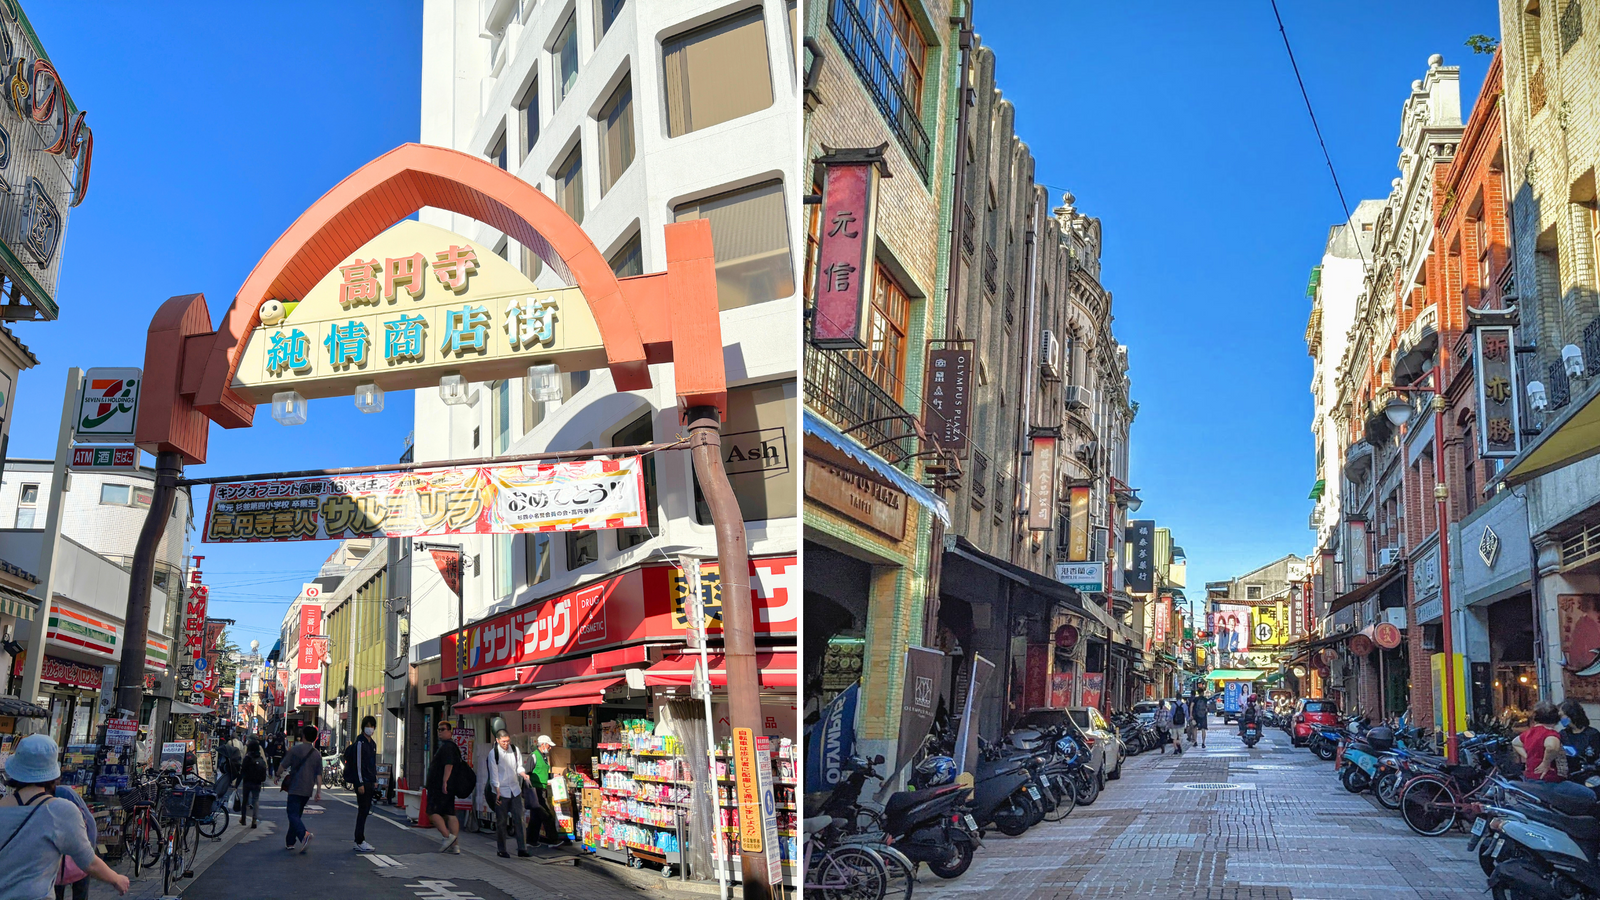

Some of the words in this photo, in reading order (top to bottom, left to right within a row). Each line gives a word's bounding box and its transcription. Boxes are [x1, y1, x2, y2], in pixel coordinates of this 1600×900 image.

[824, 210, 858, 292] 元信
[338, 245, 478, 308] 高円寺
[266, 296, 559, 375] 純情商店街
[955, 356, 965, 406] OLYMPUS
[953, 409, 962, 442] PLAZA
[75, 451, 93, 463] ATM
[97, 451, 111, 464] 酒
[115, 451, 133, 464] たばこ
[726, 441, 779, 462] Ash
[872, 483, 900, 510] PLAZA
[211, 509, 319, 539] 高円寺芸人
[581, 595, 600, 609] DRUG
[588, 610, 594, 620] &
[305, 609, 315, 664] 三菱UJ銀行
[483, 598, 572, 665] サンドラッグ
[580, 620, 604, 635] COSMETIC
[1259, 626, 1268, 639] 4
